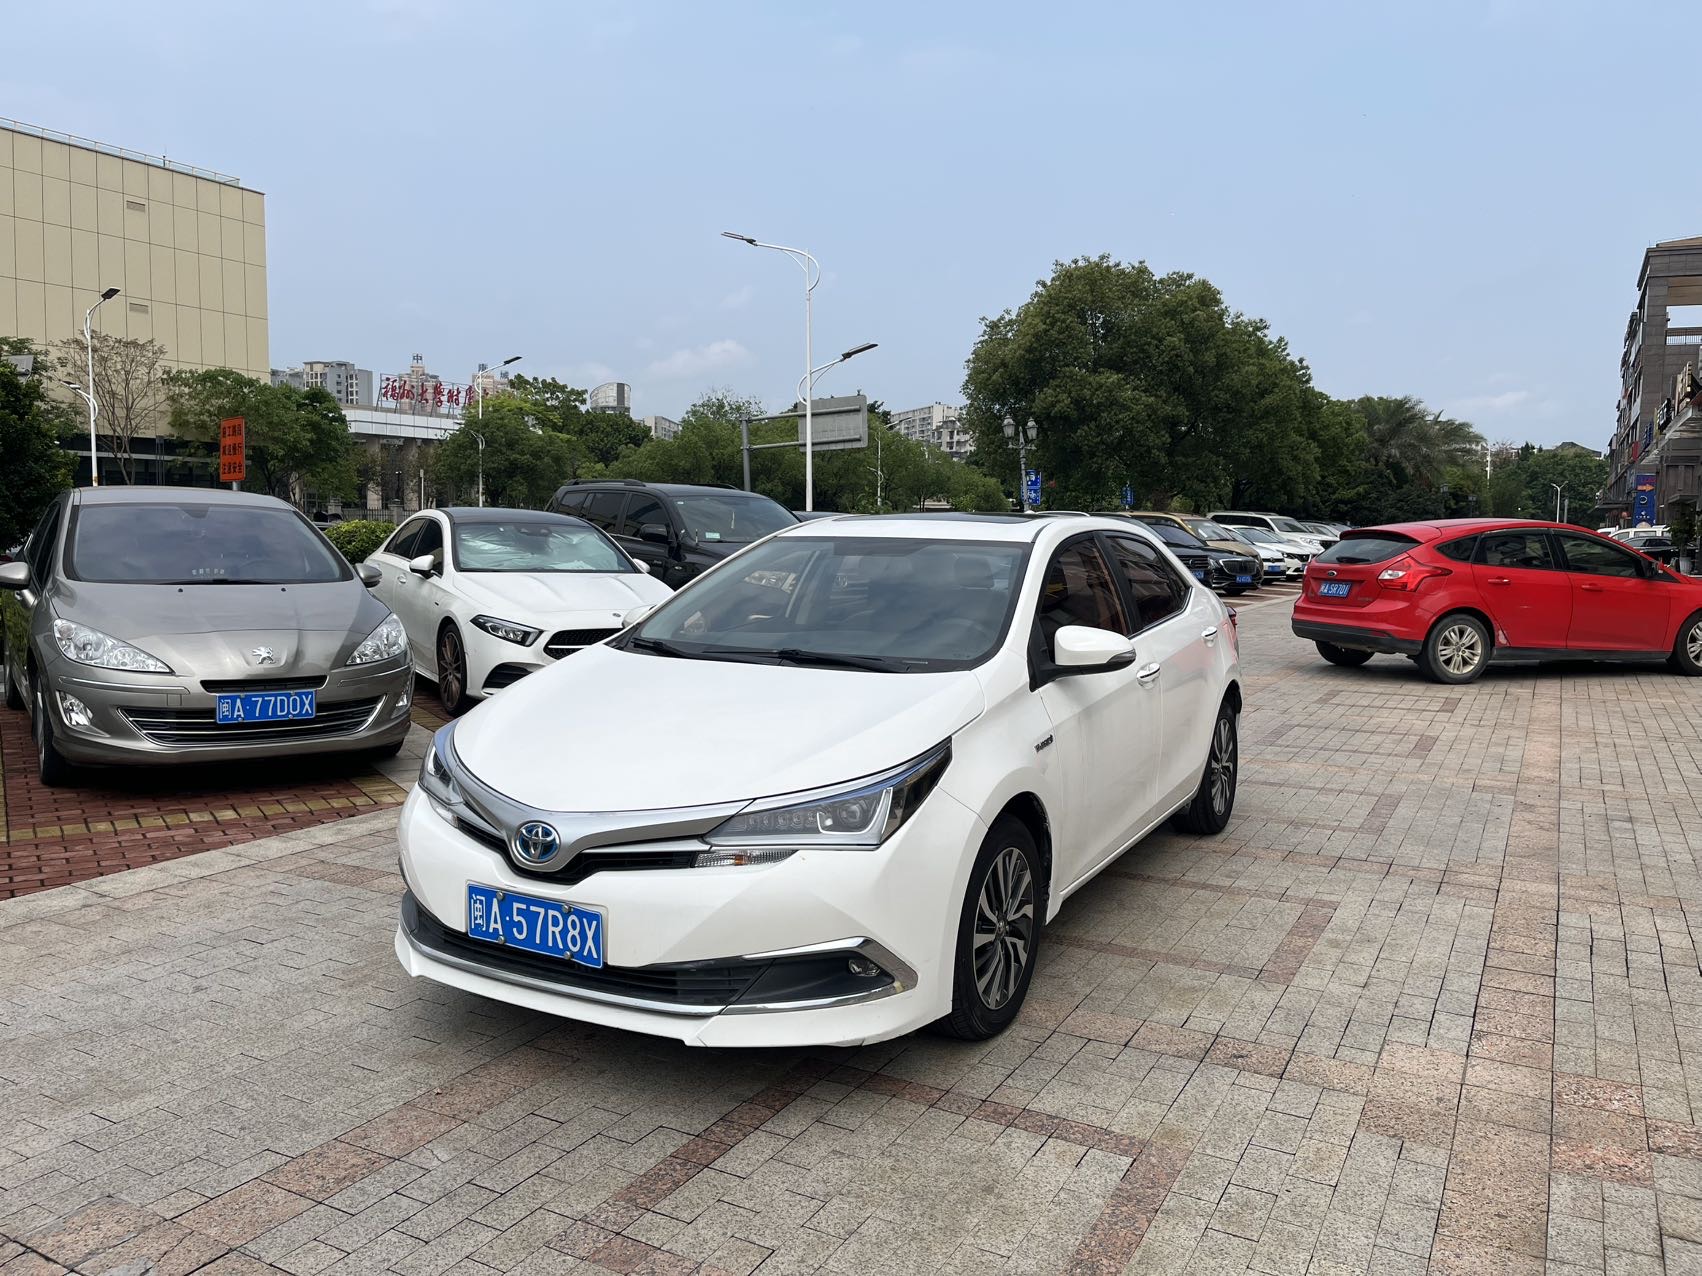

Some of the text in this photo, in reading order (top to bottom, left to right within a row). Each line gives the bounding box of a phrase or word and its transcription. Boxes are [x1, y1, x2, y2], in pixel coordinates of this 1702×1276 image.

[222, 462, 243, 474] 注意安全
[471, 893, 598, 959] 闽A·57R8X
